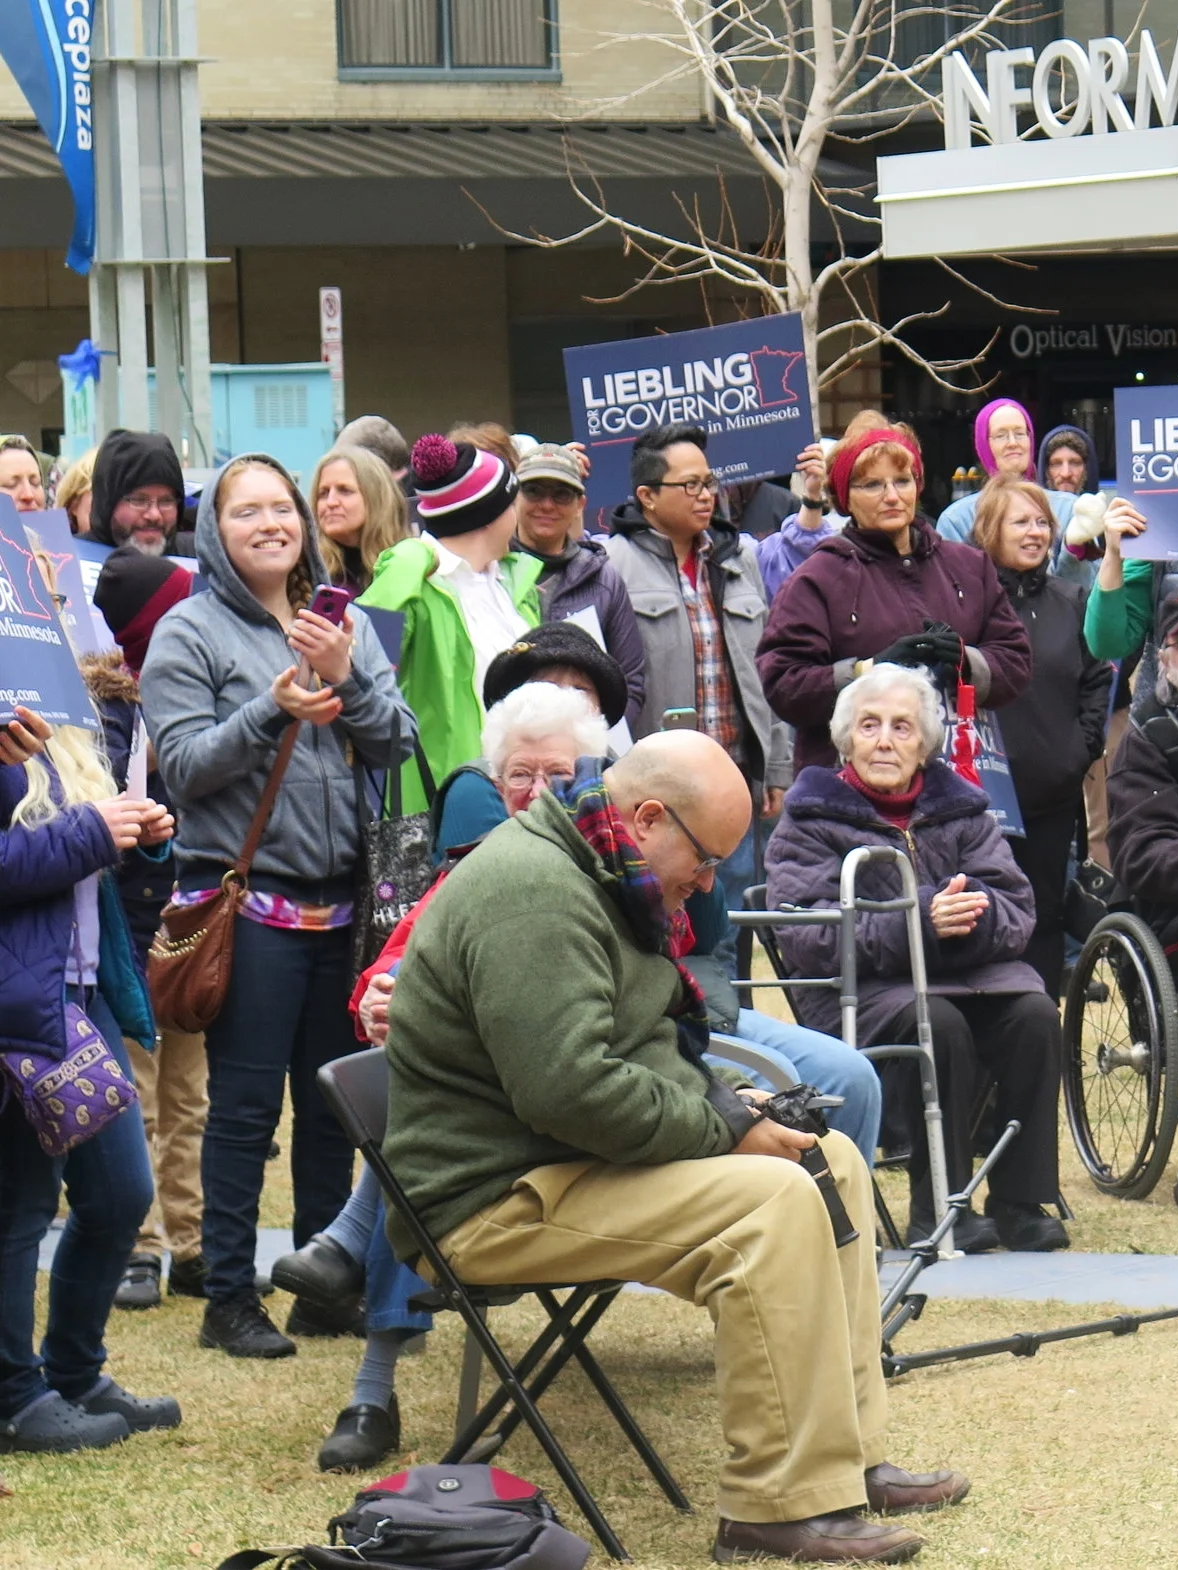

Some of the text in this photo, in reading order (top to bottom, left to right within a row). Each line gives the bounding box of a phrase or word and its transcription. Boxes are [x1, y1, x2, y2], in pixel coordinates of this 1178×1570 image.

[1010, 323, 1098, 358] Optical
[1104, 322, 1177, 357] Vision
[582, 352, 752, 408] LIEBLING
[587, 409, 602, 436] FOR
[602, 385, 759, 434] GOVERNOR
[708, 406, 800, 434] in Minnesota
[1132, 454, 1146, 482] FOR
[0, 617, 62, 646] Minnesota
